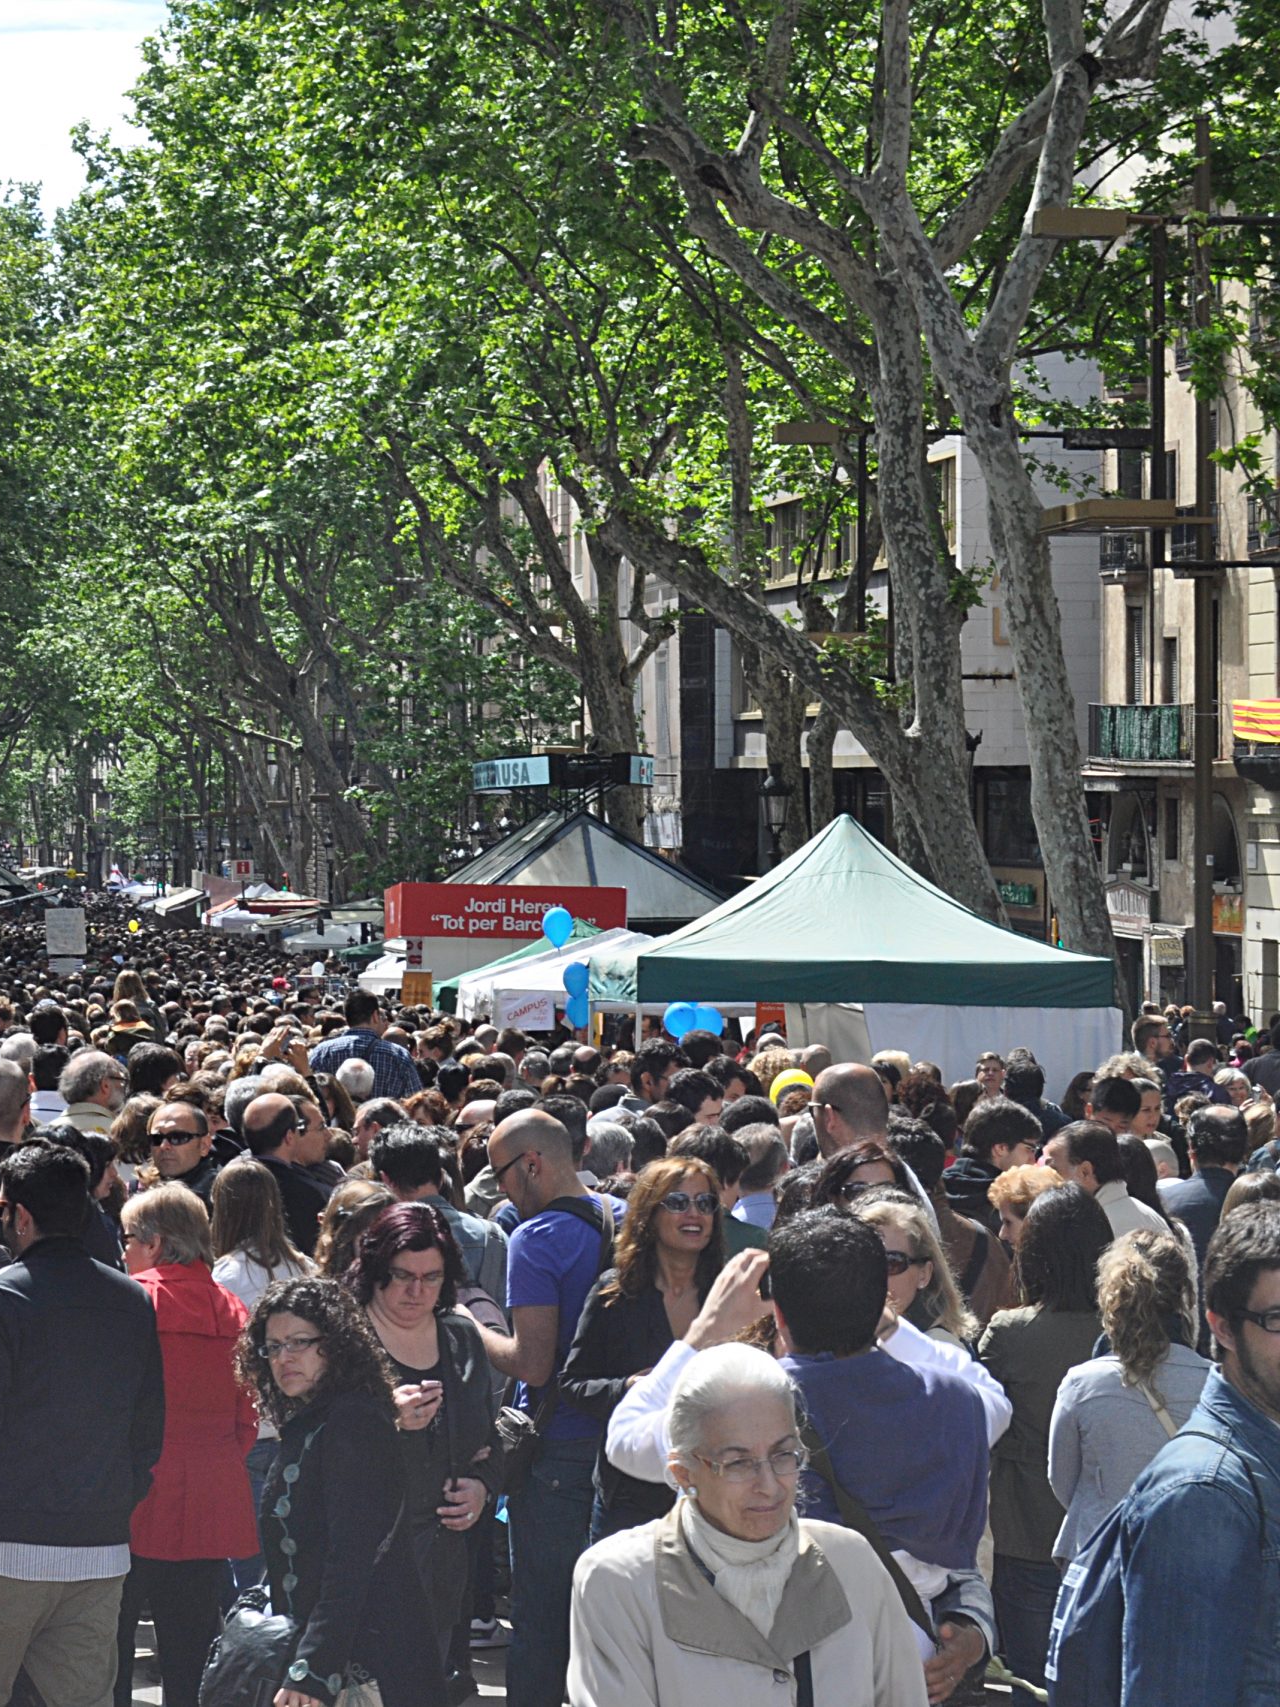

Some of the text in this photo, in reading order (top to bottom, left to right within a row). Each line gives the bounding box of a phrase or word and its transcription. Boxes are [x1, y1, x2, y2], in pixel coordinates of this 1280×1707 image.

[464, 898, 563, 914] Jordi Here
[468, 917, 498, 934] per
[507, 997, 548, 1021] CAMPUS
